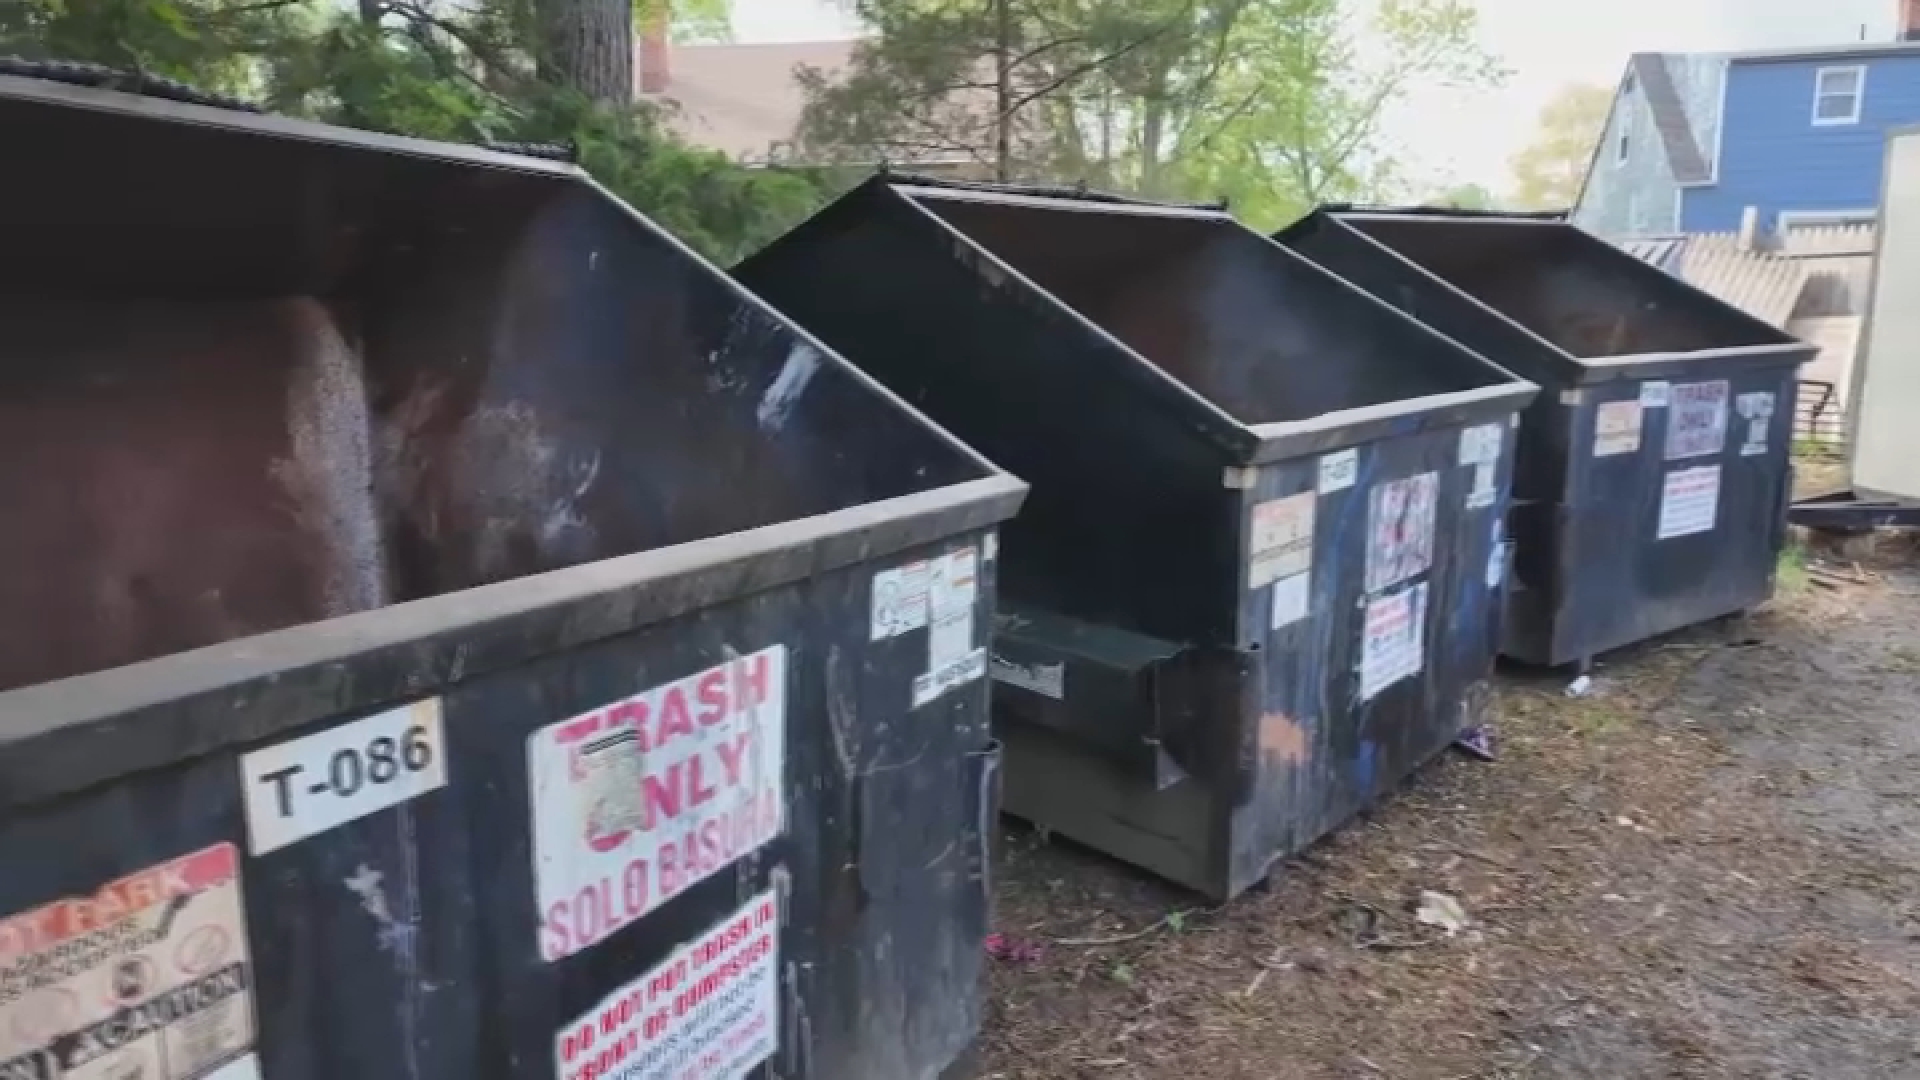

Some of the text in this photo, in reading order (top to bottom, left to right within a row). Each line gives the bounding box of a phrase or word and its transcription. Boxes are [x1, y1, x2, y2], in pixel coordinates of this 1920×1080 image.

[258, 725, 433, 818] T-086
[545, 858, 649, 960] SOLO
[562, 1023, 594, 1064] DO
[600, 988, 643, 1035] NOT
[648, 958, 688, 1002] PUT
[692, 914, 752, 971] TRASH
[671, 933, 772, 1018] DUMPSTER
